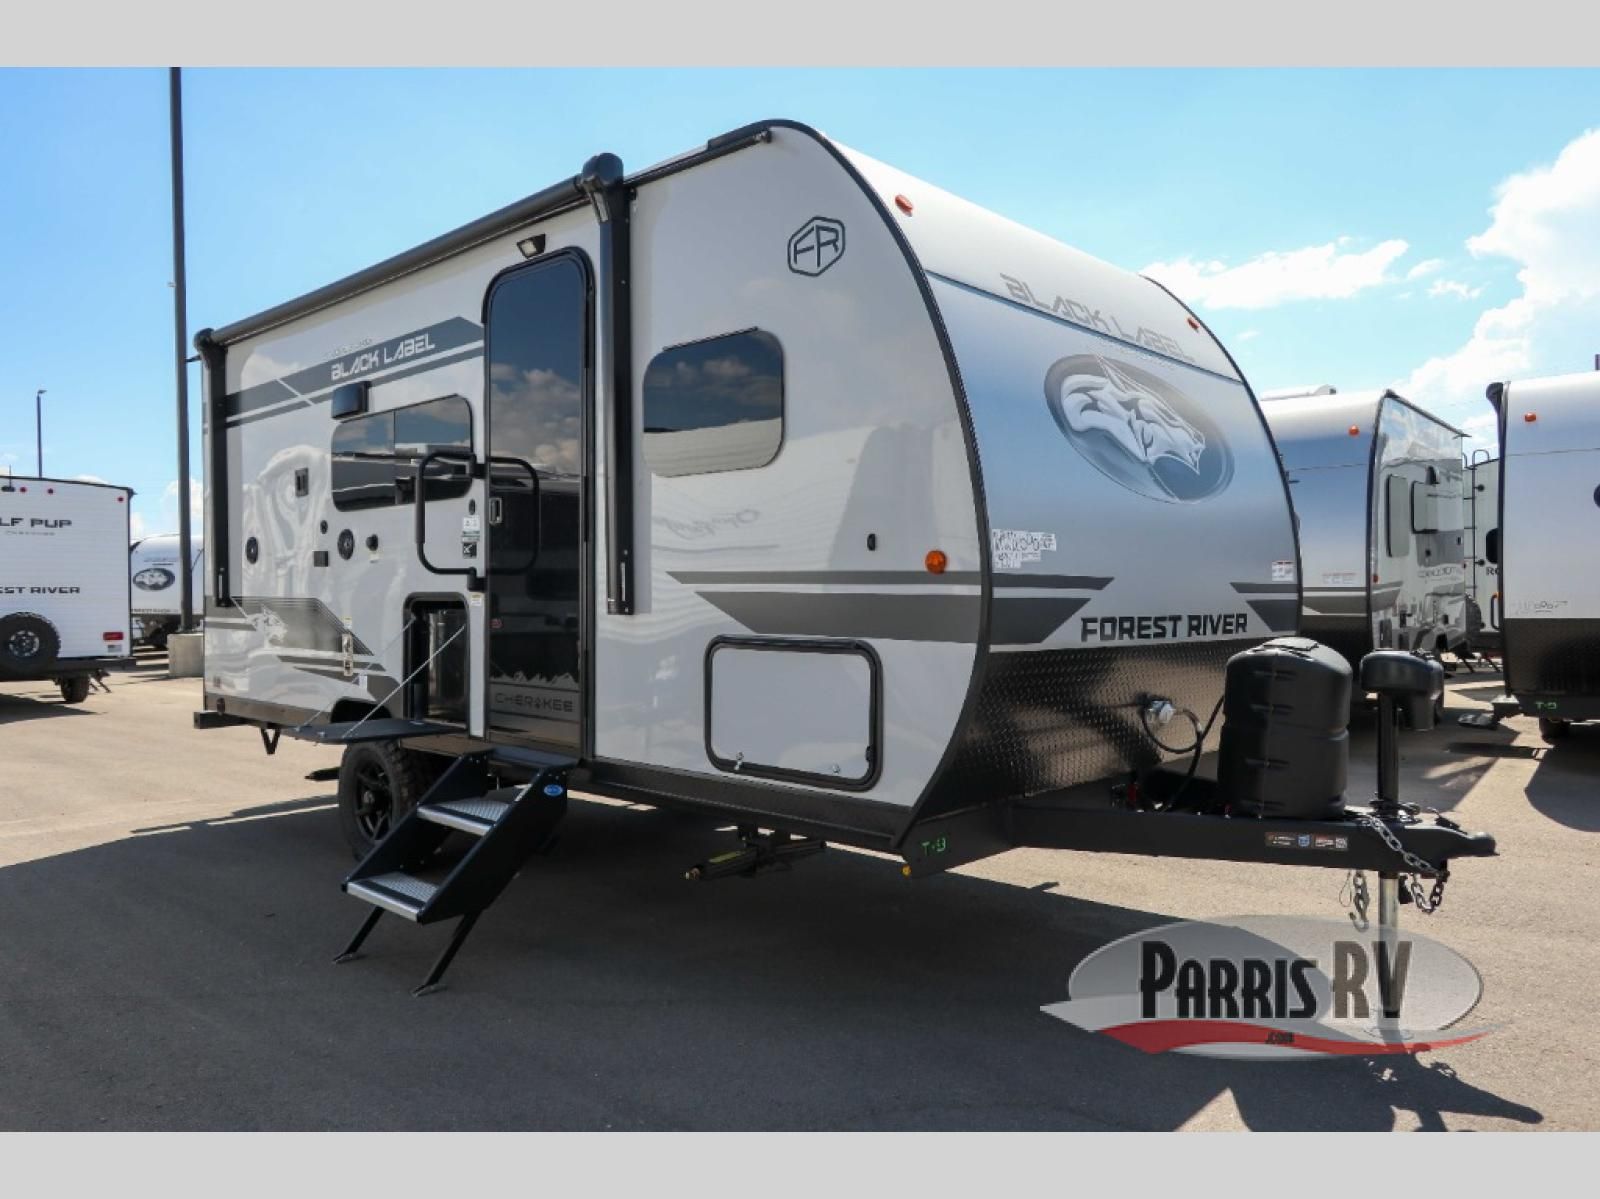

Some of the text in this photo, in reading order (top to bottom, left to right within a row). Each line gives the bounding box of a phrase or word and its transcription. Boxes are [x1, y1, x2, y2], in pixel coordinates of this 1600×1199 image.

[1000, 272, 1196, 363] BLACK LABEL
[330, 350, 380, 381] BLACK
[383, 333, 436, 366] LABEL
[30, 518, 73, 528] PUP
[30, 586, 81, 595] RIVER
[1081, 613, 1248, 642] FOREST RIVER
